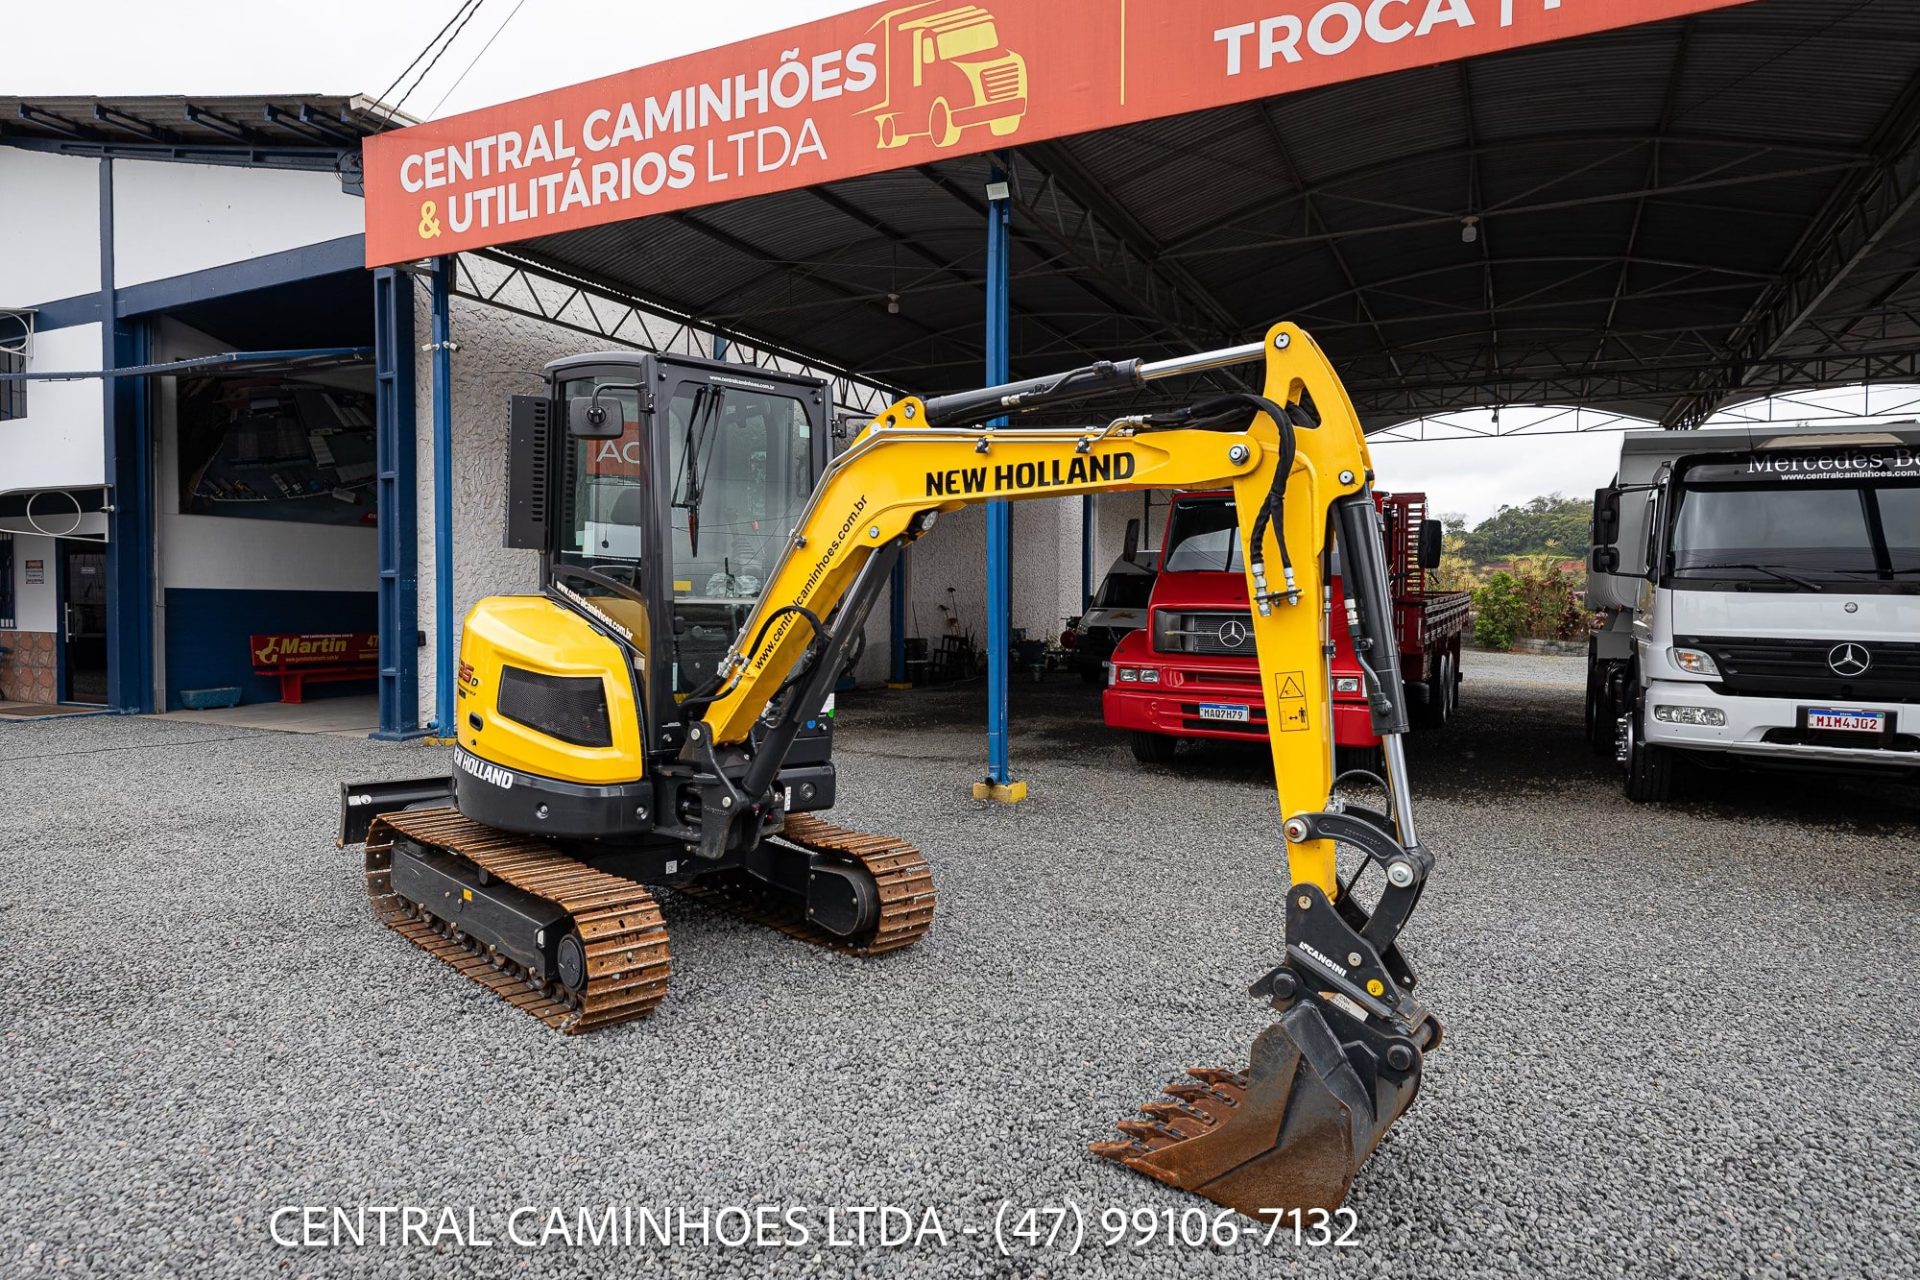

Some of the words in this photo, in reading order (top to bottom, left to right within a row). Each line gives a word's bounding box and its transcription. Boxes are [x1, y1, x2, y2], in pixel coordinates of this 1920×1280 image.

[1214, 0, 1475, 76] TROCA
[400, 119, 576, 193] CENTRAL
[583, 42, 878, 152] CAMINHÕES
[418, 200, 442, 240] &
[448, 144, 696, 233] UTILITÁRIOS
[708, 117, 828, 182] LTDA
[926, 467, 987, 497] NEW
[994, 451, 1136, 491] HOLLAND
[1780, 469, 1920, 481] www.centralcaminhoes.com.
[281, 638, 347, 654] Martin
[461, 754, 514, 790] HOLLAND
[1305, 944, 1348, 978] CANGINI
